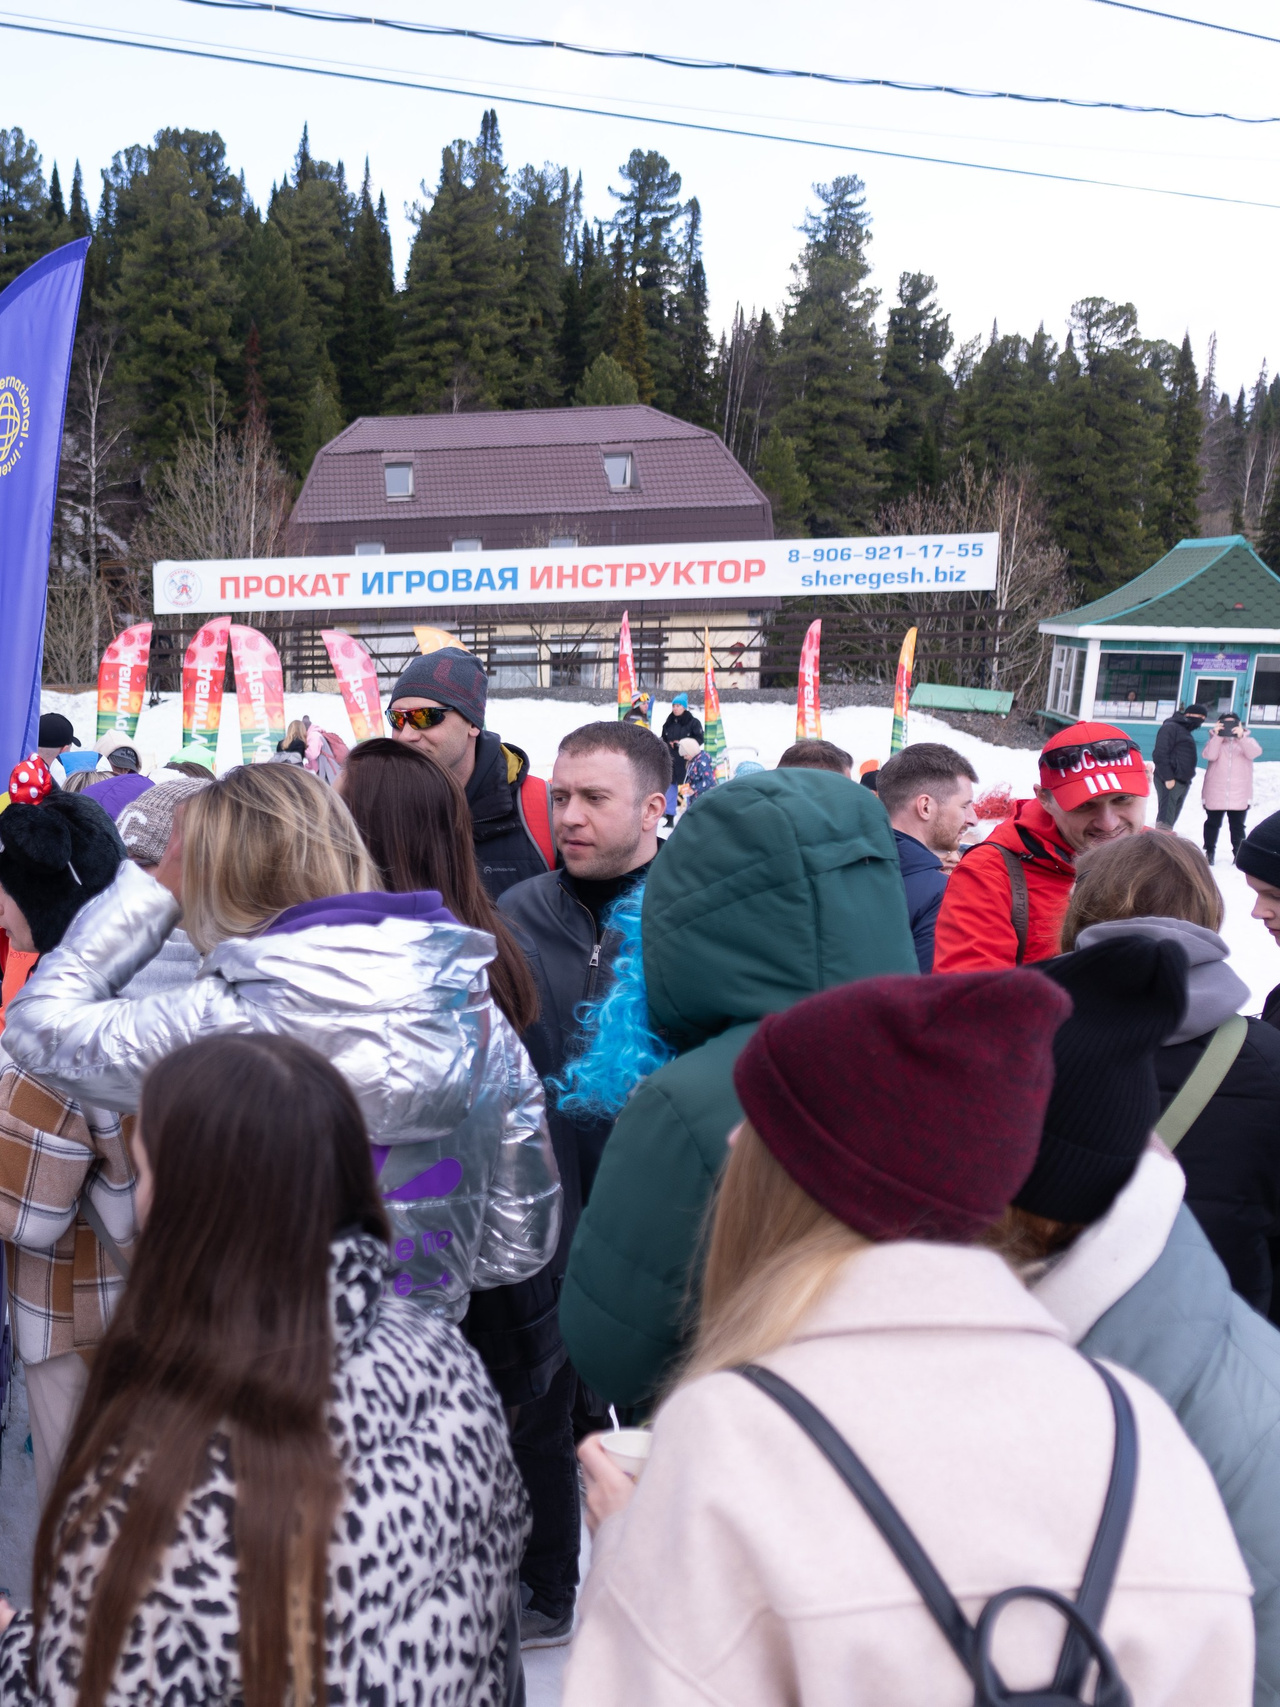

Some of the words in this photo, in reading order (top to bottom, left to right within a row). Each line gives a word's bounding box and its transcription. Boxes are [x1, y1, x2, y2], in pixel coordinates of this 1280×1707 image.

[788, 543, 984, 563] 8-906-921-17-55
[220, 573, 351, 600] ПРОКАТ
[362, 567, 519, 596] ИГРОВАЯ
[529, 558, 766, 590] ИНСТРУКТОР
[801, 565, 967, 590] sheregesh.biz
[114, 651, 135, 732] рутилад
[190, 661, 214, 745] утилад
[422, 1230, 454, 1257] по
